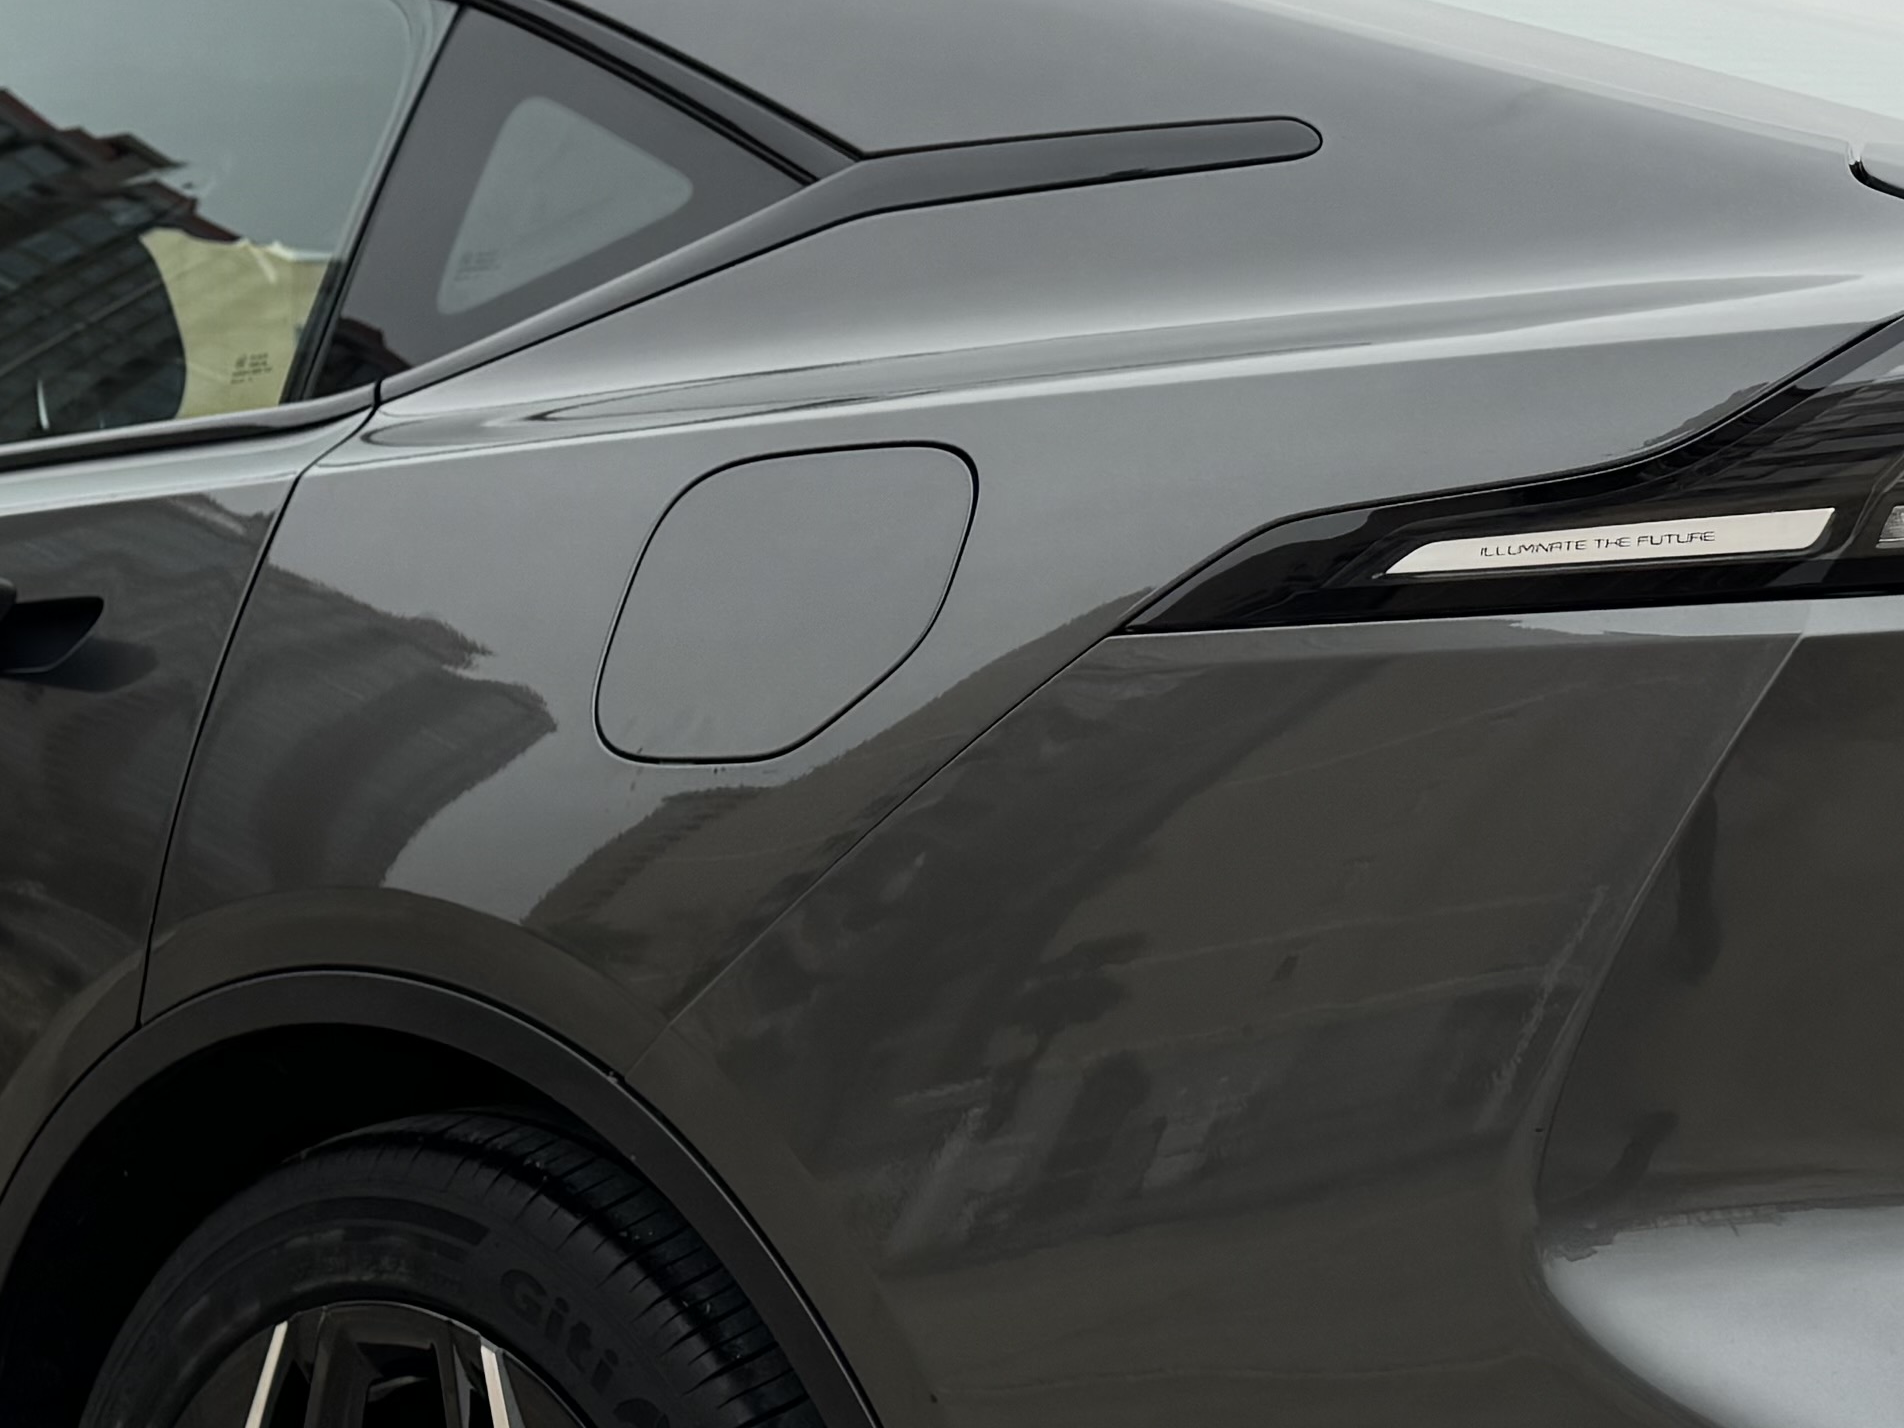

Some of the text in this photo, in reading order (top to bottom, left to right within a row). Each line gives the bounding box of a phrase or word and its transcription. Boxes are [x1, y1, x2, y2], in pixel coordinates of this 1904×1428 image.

[1594, 536, 1632, 549] THE
[1637, 531, 1716, 547] FUTURE
[500, 1268, 620, 1395] Giti
